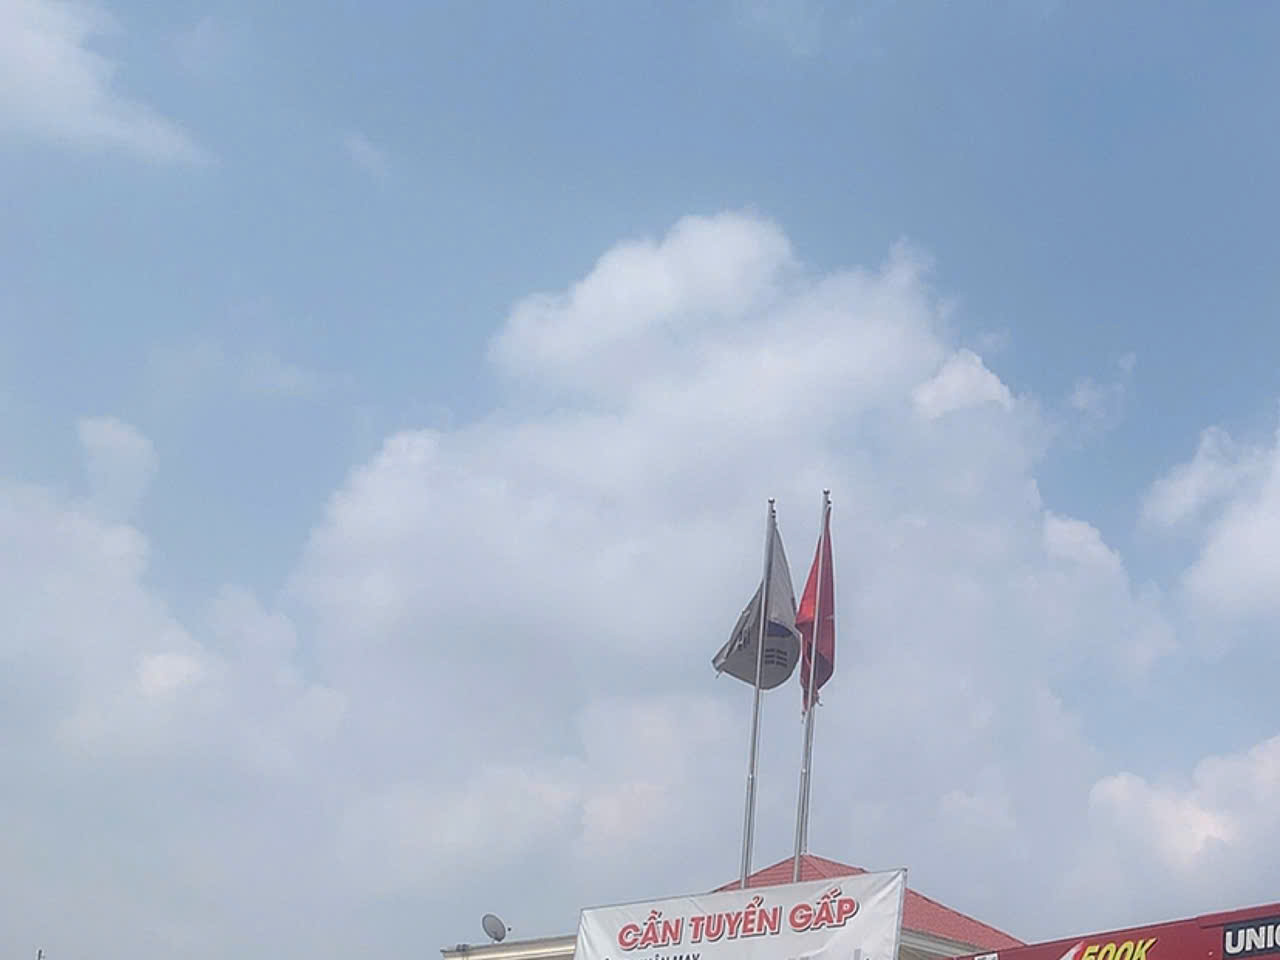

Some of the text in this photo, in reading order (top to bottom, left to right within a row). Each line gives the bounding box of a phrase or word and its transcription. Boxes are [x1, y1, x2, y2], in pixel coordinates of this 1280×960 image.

[617, 888, 859, 950] CẦN TUYỂN GẤP
